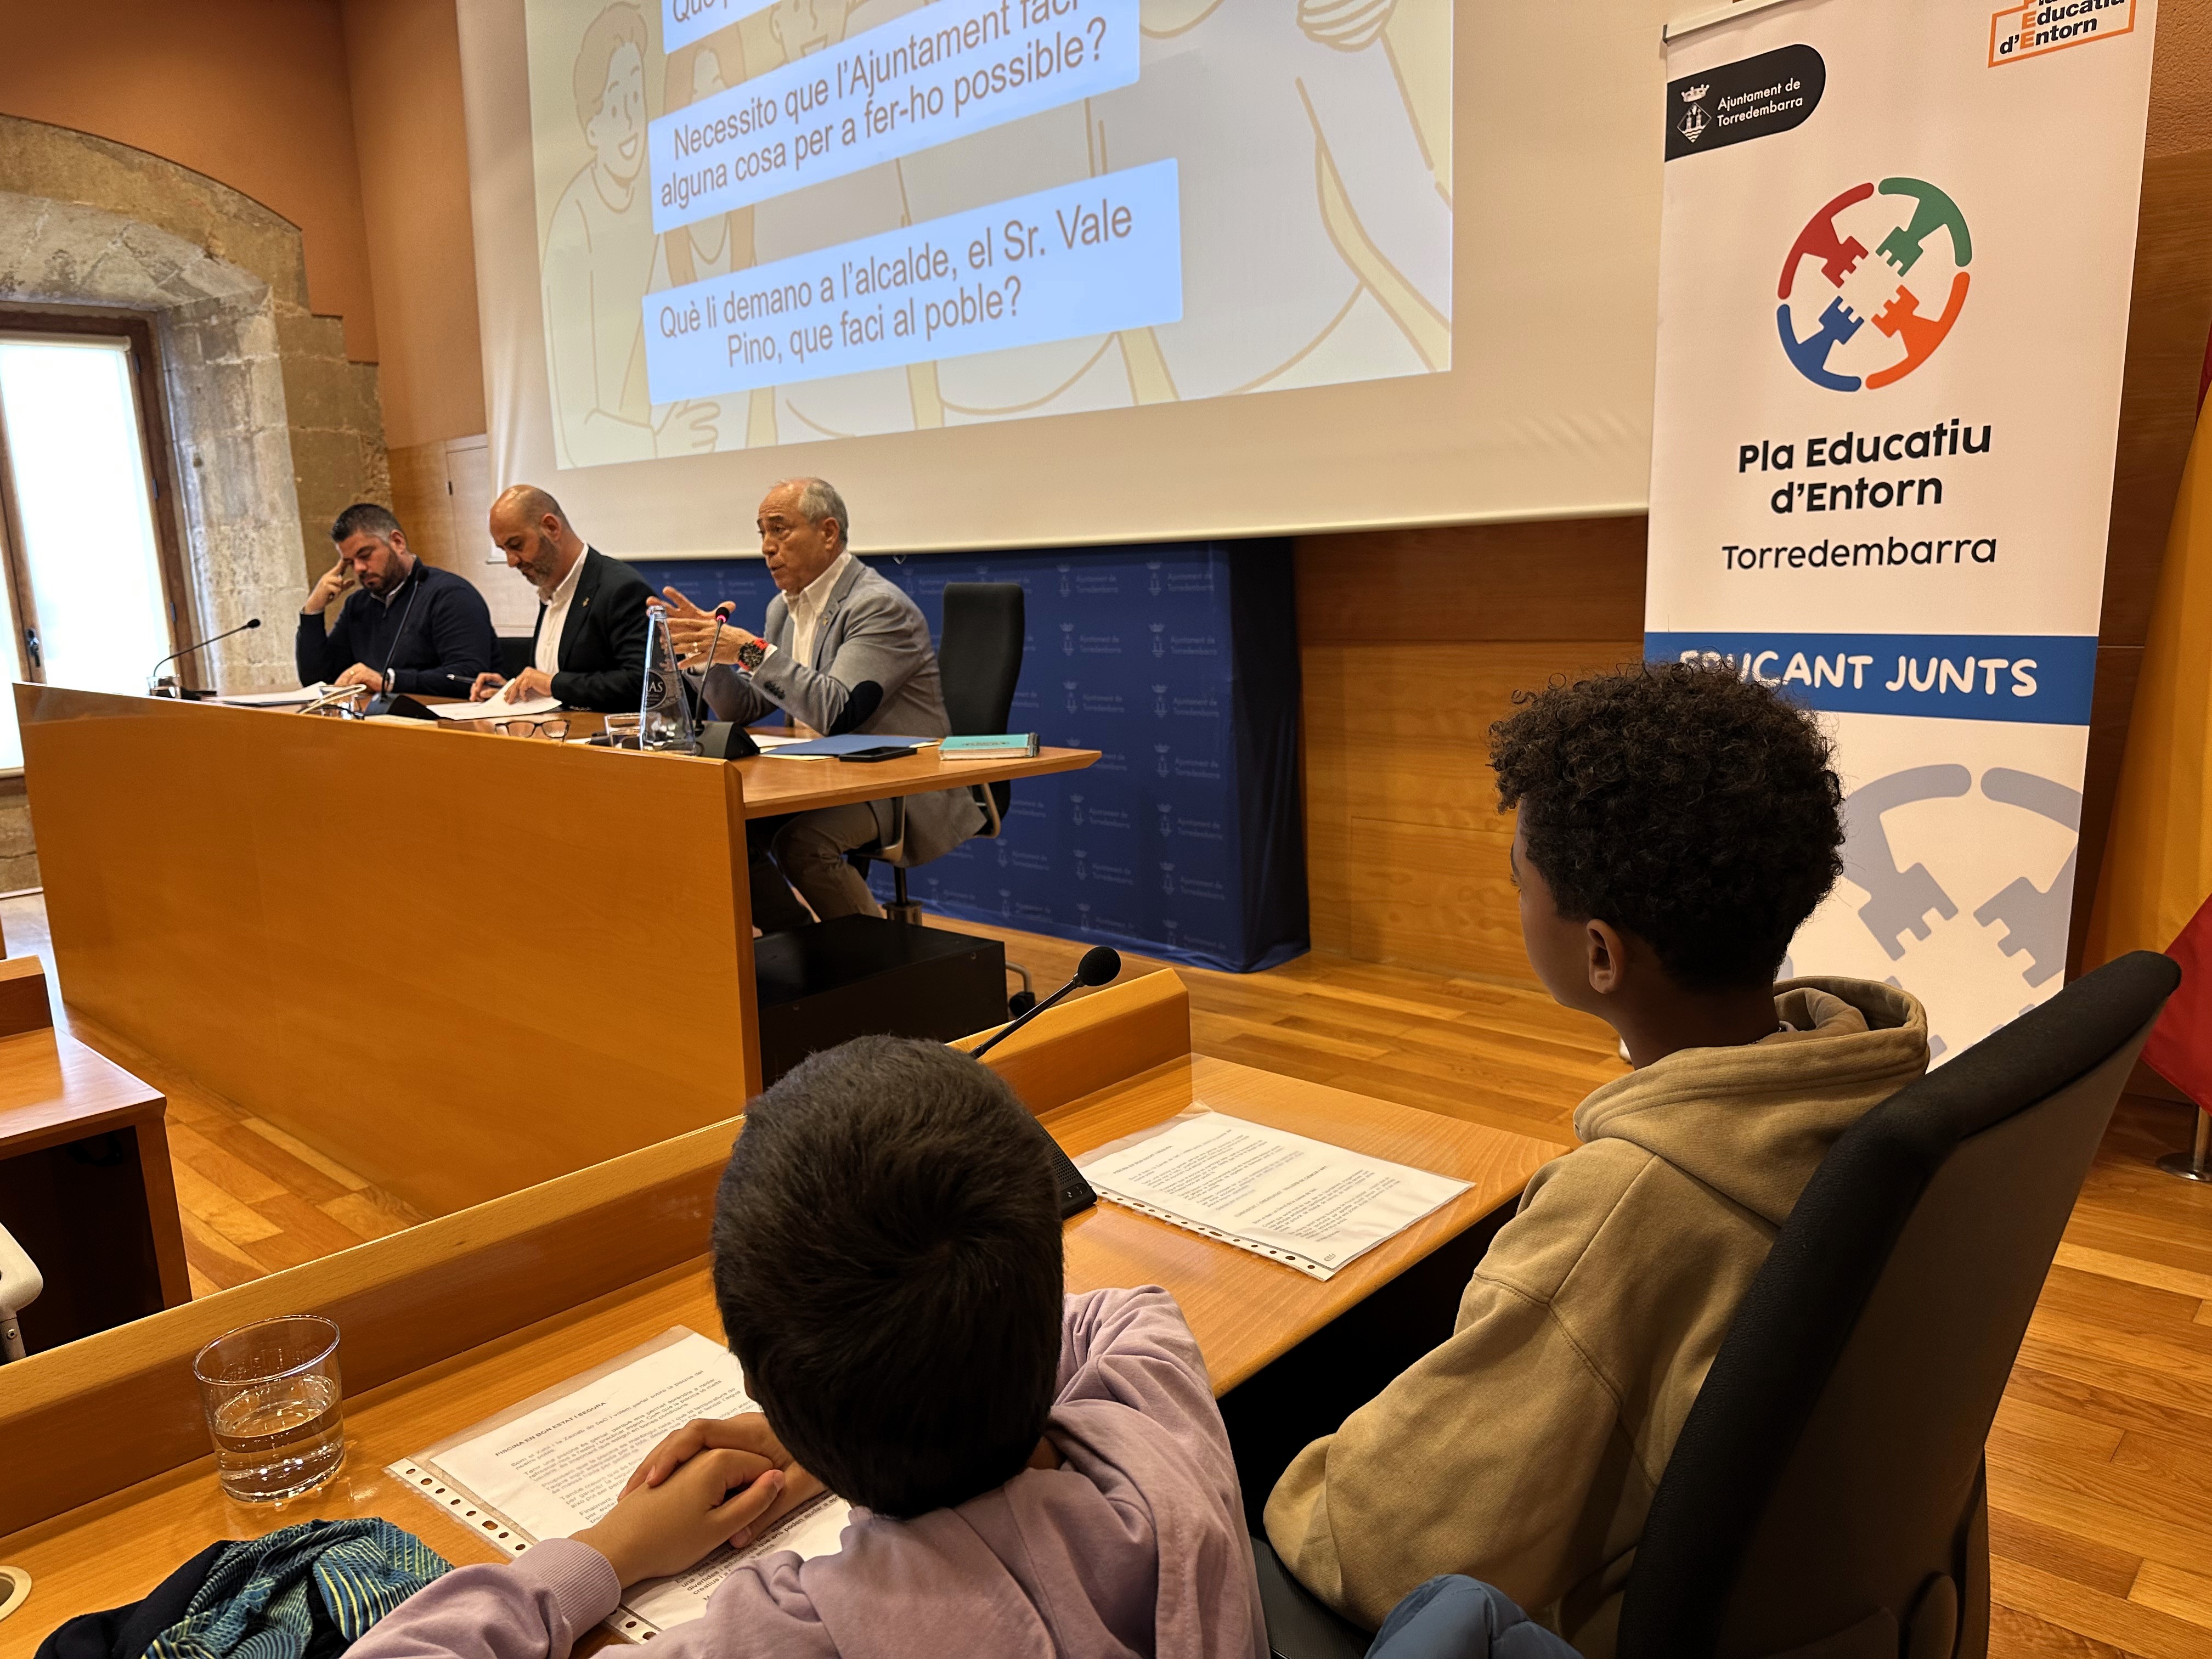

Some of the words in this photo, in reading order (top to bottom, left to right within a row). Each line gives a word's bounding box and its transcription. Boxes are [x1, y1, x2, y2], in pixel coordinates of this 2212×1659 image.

[674, 98, 777, 159] Necessito
[785, 79, 828, 123] que
[837, 4, 1010, 98] l'Ajuntament
[1717, 83, 1782, 111] Ajuntament
[1785, 77, 1801, 92] de
[662, 162, 727, 209] alguna
[734, 142, 786, 182] cosa
[794, 125, 833, 170] per
[842, 120, 855, 145] a
[865, 86, 944, 137] fer-ho
[954, 16, 1106, 117] possible?
[1717, 97, 1803, 127] Torredembarra
[660, 306, 700, 338] Què
[707, 298, 716, 326] li
[724, 282, 811, 324] demano
[821, 276, 833, 302] a
[843, 243, 956, 297] l'alcalde,
[968, 228, 992, 269] el
[1004, 220, 1045, 261] Sr.
[1056, 199, 1131, 249] Vale
[727, 334, 781, 365] Pino,
[789, 324, 832, 362] que
[840, 304, 883, 345] faci
[894, 298, 915, 336] al
[925, 275, 1021, 340] poble?
[1740, 441, 1793, 472] Pla
[1807, 419, 1991, 467] Educatiu
[1771, 477, 1942, 514] d'Entorn
[1723, 537, 1996, 569] Torredembarra
[1886, 656, 2036, 696] JUNTS
[646, 1403, 667, 1415] permet
[668, 1391, 693, 1403] aprendre
[650, 1390, 667, 1398] sobre
[495, 1442, 524, 1456] PISCINA
[535, 1428, 552, 1437] BON
[552, 1417, 573, 1429] ESTAT
[578, 1402, 606, 1416] SEGURA
[639, 1419, 658, 1428] bones
[681, 1578, 696, 1588] una
[756, 1534, 767, 1543] per
[687, 1570, 720, 1592] divertides
[724, 1547, 758, 1569] educatives
[758, 1538, 771, 1548] que
[772, 1531, 784, 1540] ens
[784, 1518, 804, 1532] poden
[804, 1506, 822, 1519] ajudar
[693, 1577, 720, 1594] creatius
